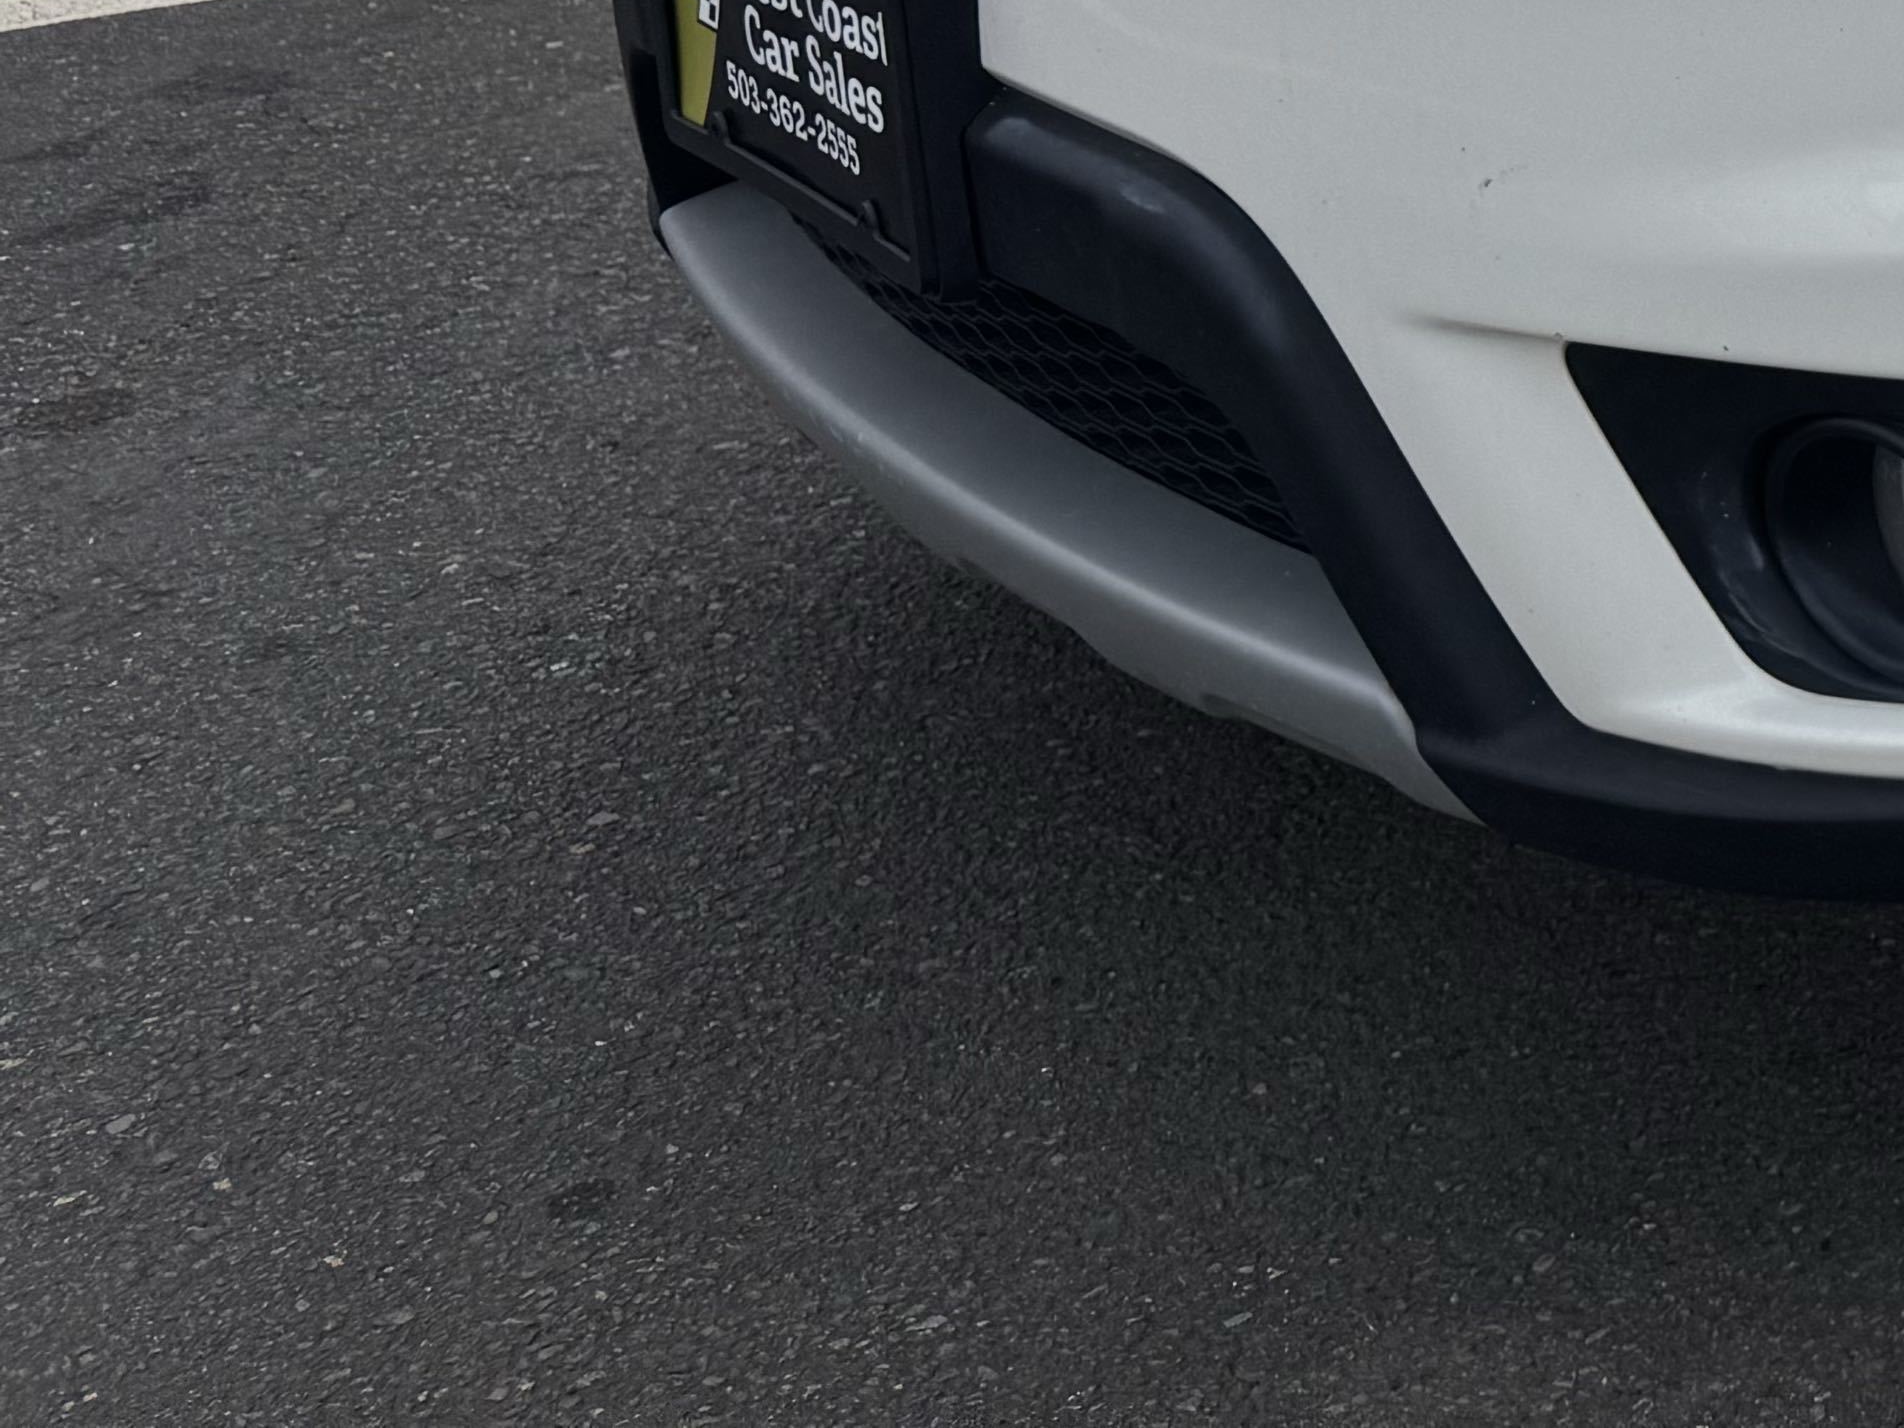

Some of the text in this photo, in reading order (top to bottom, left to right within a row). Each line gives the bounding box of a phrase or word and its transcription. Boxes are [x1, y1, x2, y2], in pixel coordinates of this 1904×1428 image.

[726, 60, 861, 176] 503-362-2555
[744, 4, 884, 133] Car Sales
